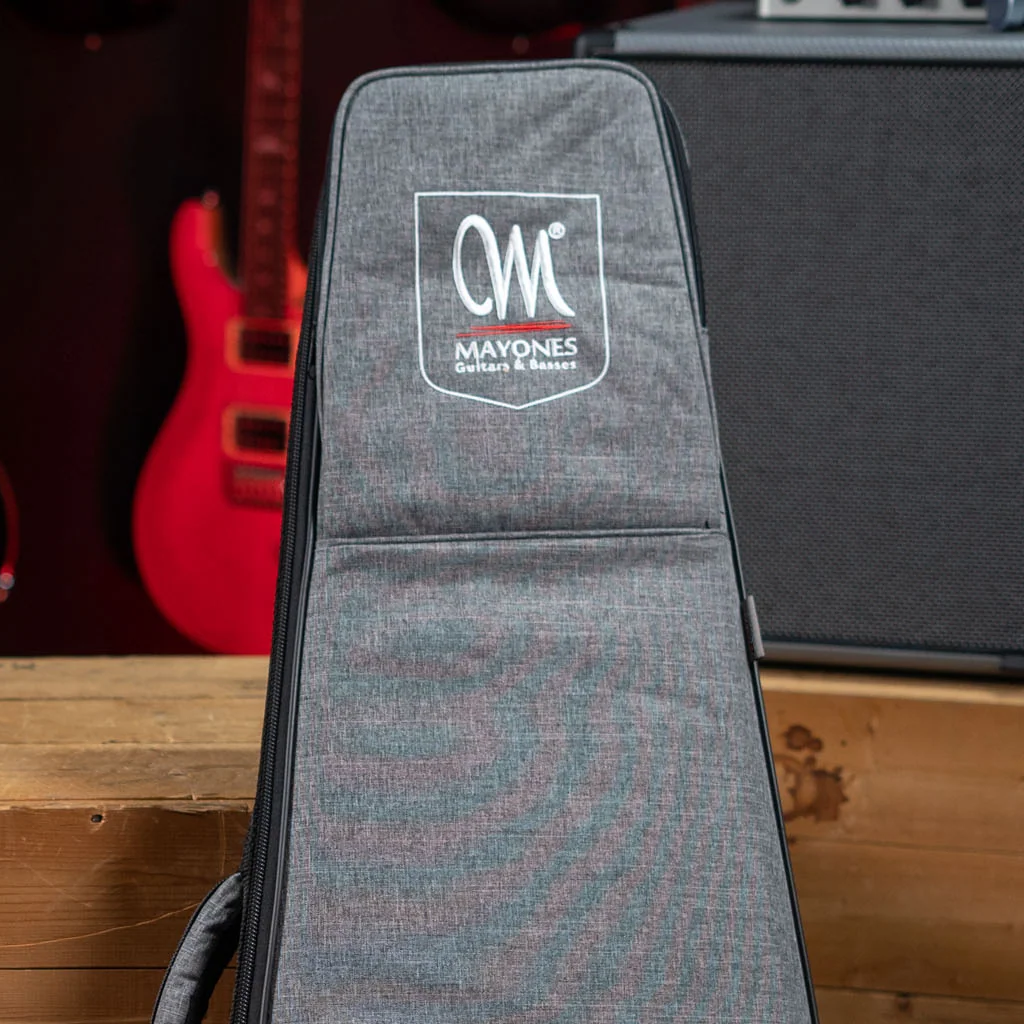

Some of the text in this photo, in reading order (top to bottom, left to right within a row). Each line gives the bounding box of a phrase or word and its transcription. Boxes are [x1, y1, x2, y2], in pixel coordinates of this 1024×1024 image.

[455, 337, 578, 360] MAYONES
[455, 361, 510, 373] Guitars
[530, 359, 577, 370] Basses
